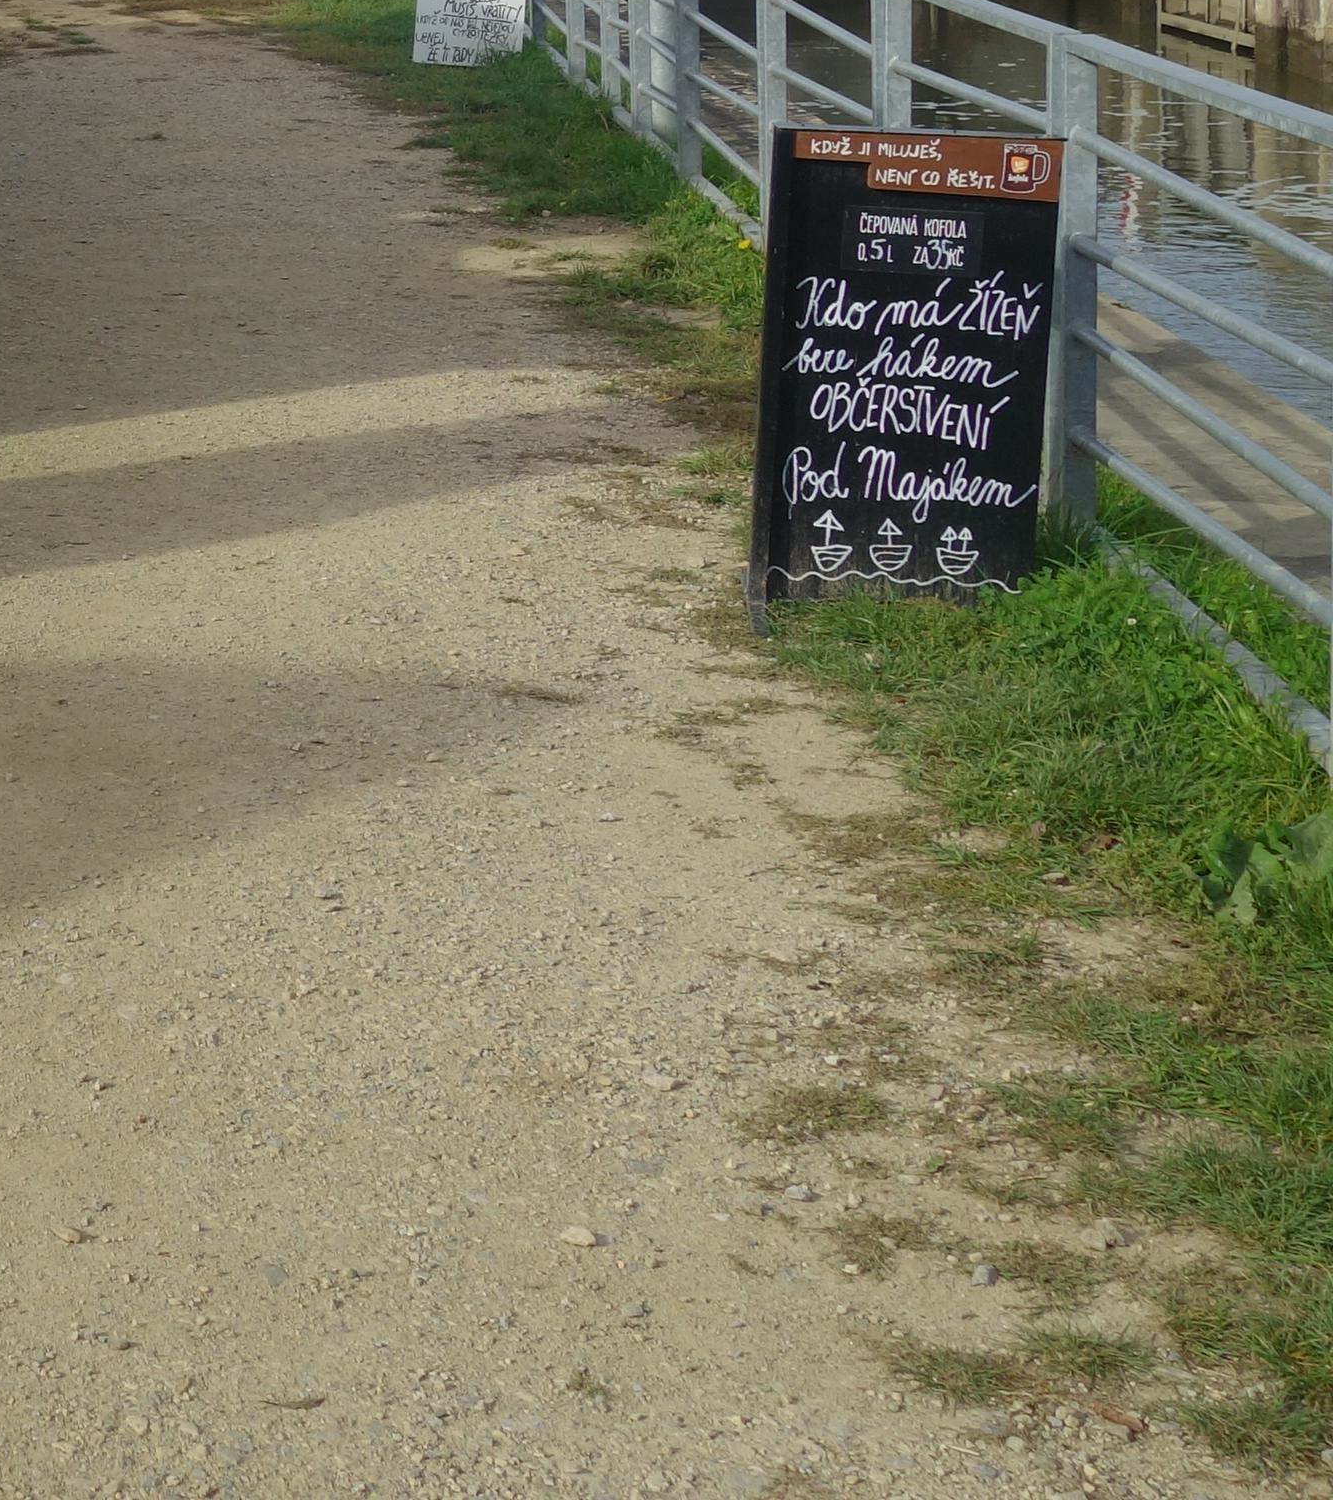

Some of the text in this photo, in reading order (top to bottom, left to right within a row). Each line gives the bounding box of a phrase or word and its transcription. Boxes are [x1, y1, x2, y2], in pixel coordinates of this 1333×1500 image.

[810, 136, 943, 162] KDYŽ JI MILUJEŠ,
[874, 167, 996, 190] NENÍ CO ŘEŠIT.
[859, 211, 968, 239] ČEPOVANÁ KOFOLA
[795, 270, 1044, 341] Kdo má ŽÍZEŇ
[782, 333, 1019, 388] bere hákem
[809, 377, 1011, 451] OBČERSTVENÍ
[782, 441, 1039, 524] Pod Majákem
